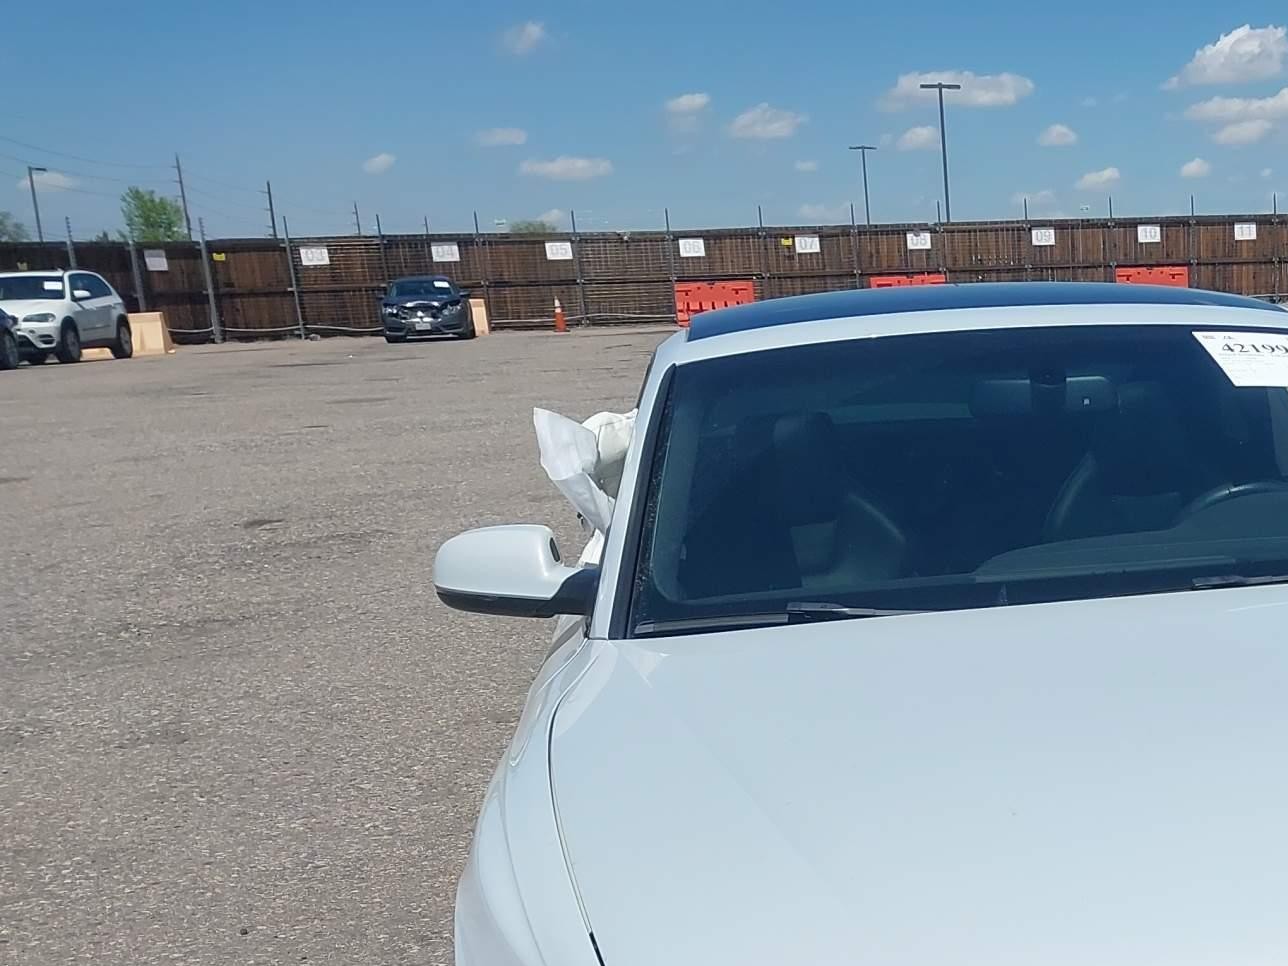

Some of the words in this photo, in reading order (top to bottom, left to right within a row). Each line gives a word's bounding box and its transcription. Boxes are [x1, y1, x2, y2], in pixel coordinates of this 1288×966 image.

[1036, 230, 1051, 242] 09
[1142, 228, 1157, 239] 10
[1239, 226, 1252, 237] 11
[799, 238, 815, 250] 07
[550, 245, 568, 256] 05
